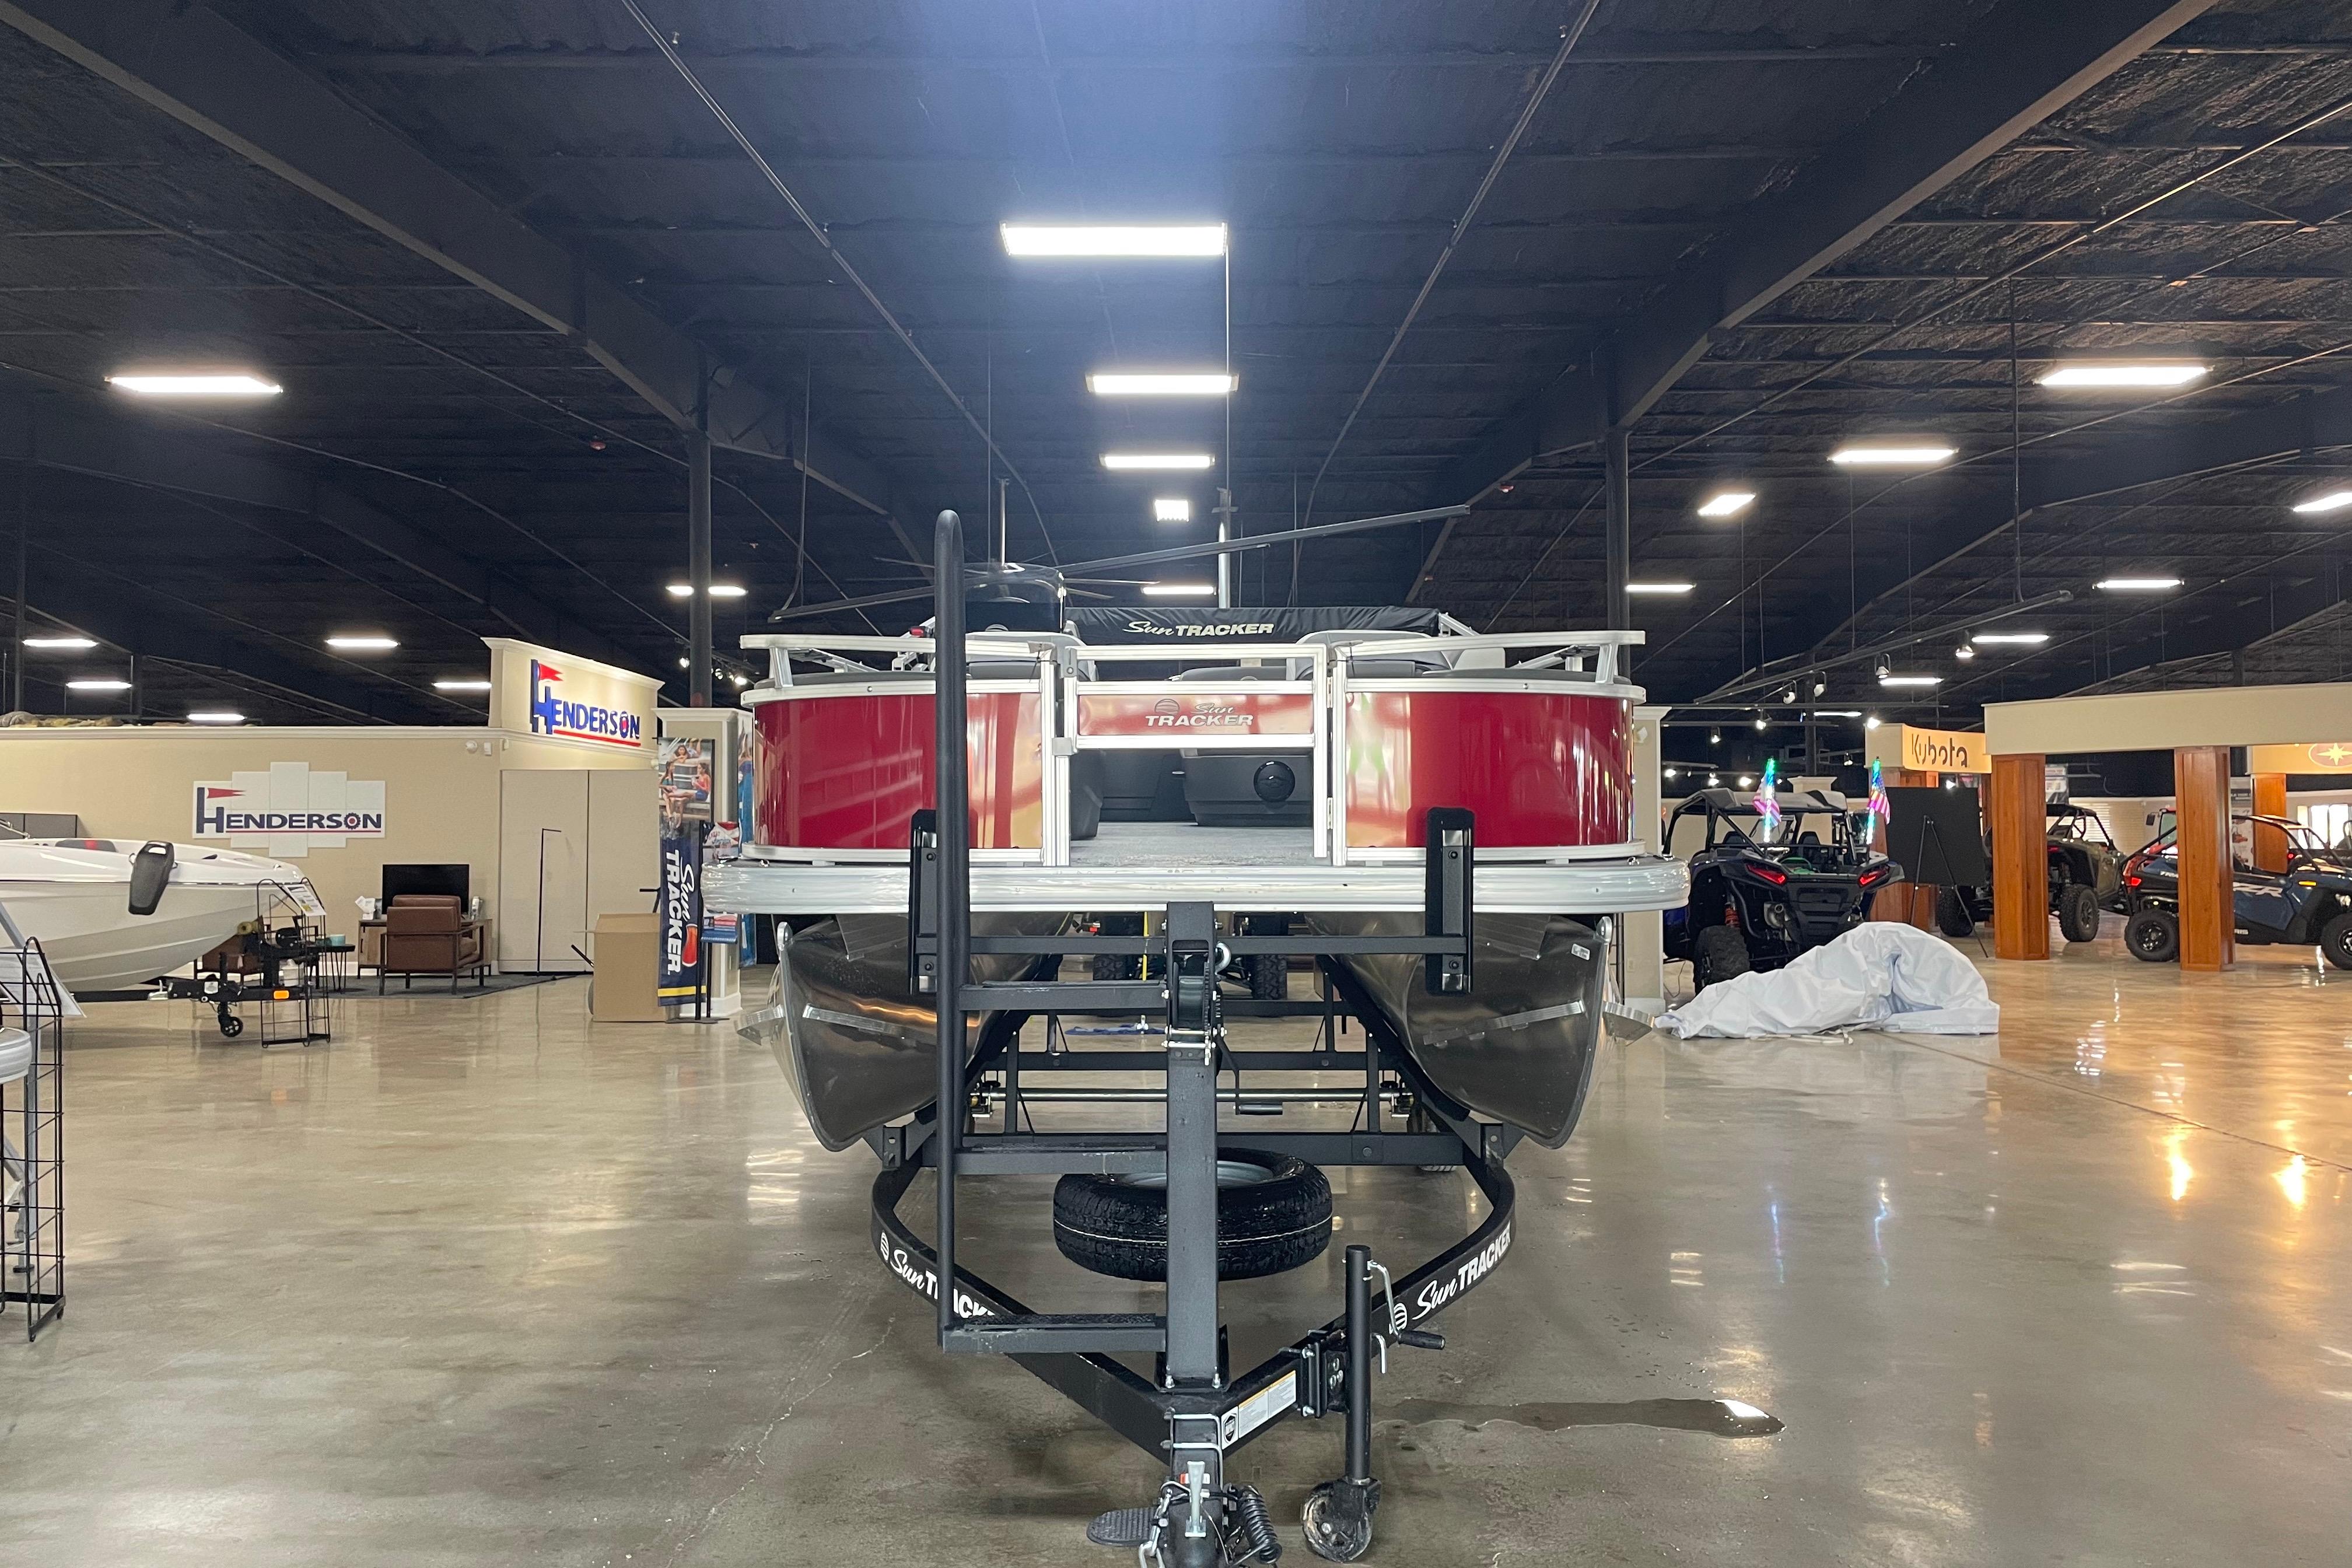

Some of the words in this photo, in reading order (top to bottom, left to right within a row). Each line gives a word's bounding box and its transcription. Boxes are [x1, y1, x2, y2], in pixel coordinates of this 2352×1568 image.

[1122, 621, 1174, 636] Sun
[1175, 623, 1275, 637] TRACKER
[530, 659, 640, 740] HENDERSON
[1145, 715, 1254, 727] TRACKER
[1191, 702, 1235, 715] Sun
[1911, 733, 1968, 768] Kubota
[196, 786, 382, 834] HENDERSON
[666, 849, 683, 974] TRACKER
[680, 856, 695, 922] Sun
[890, 1248, 925, 1290] Sun
[1412, 1278, 1458, 1321] Sun
[1458, 1220, 1511, 1291] TRACKER
